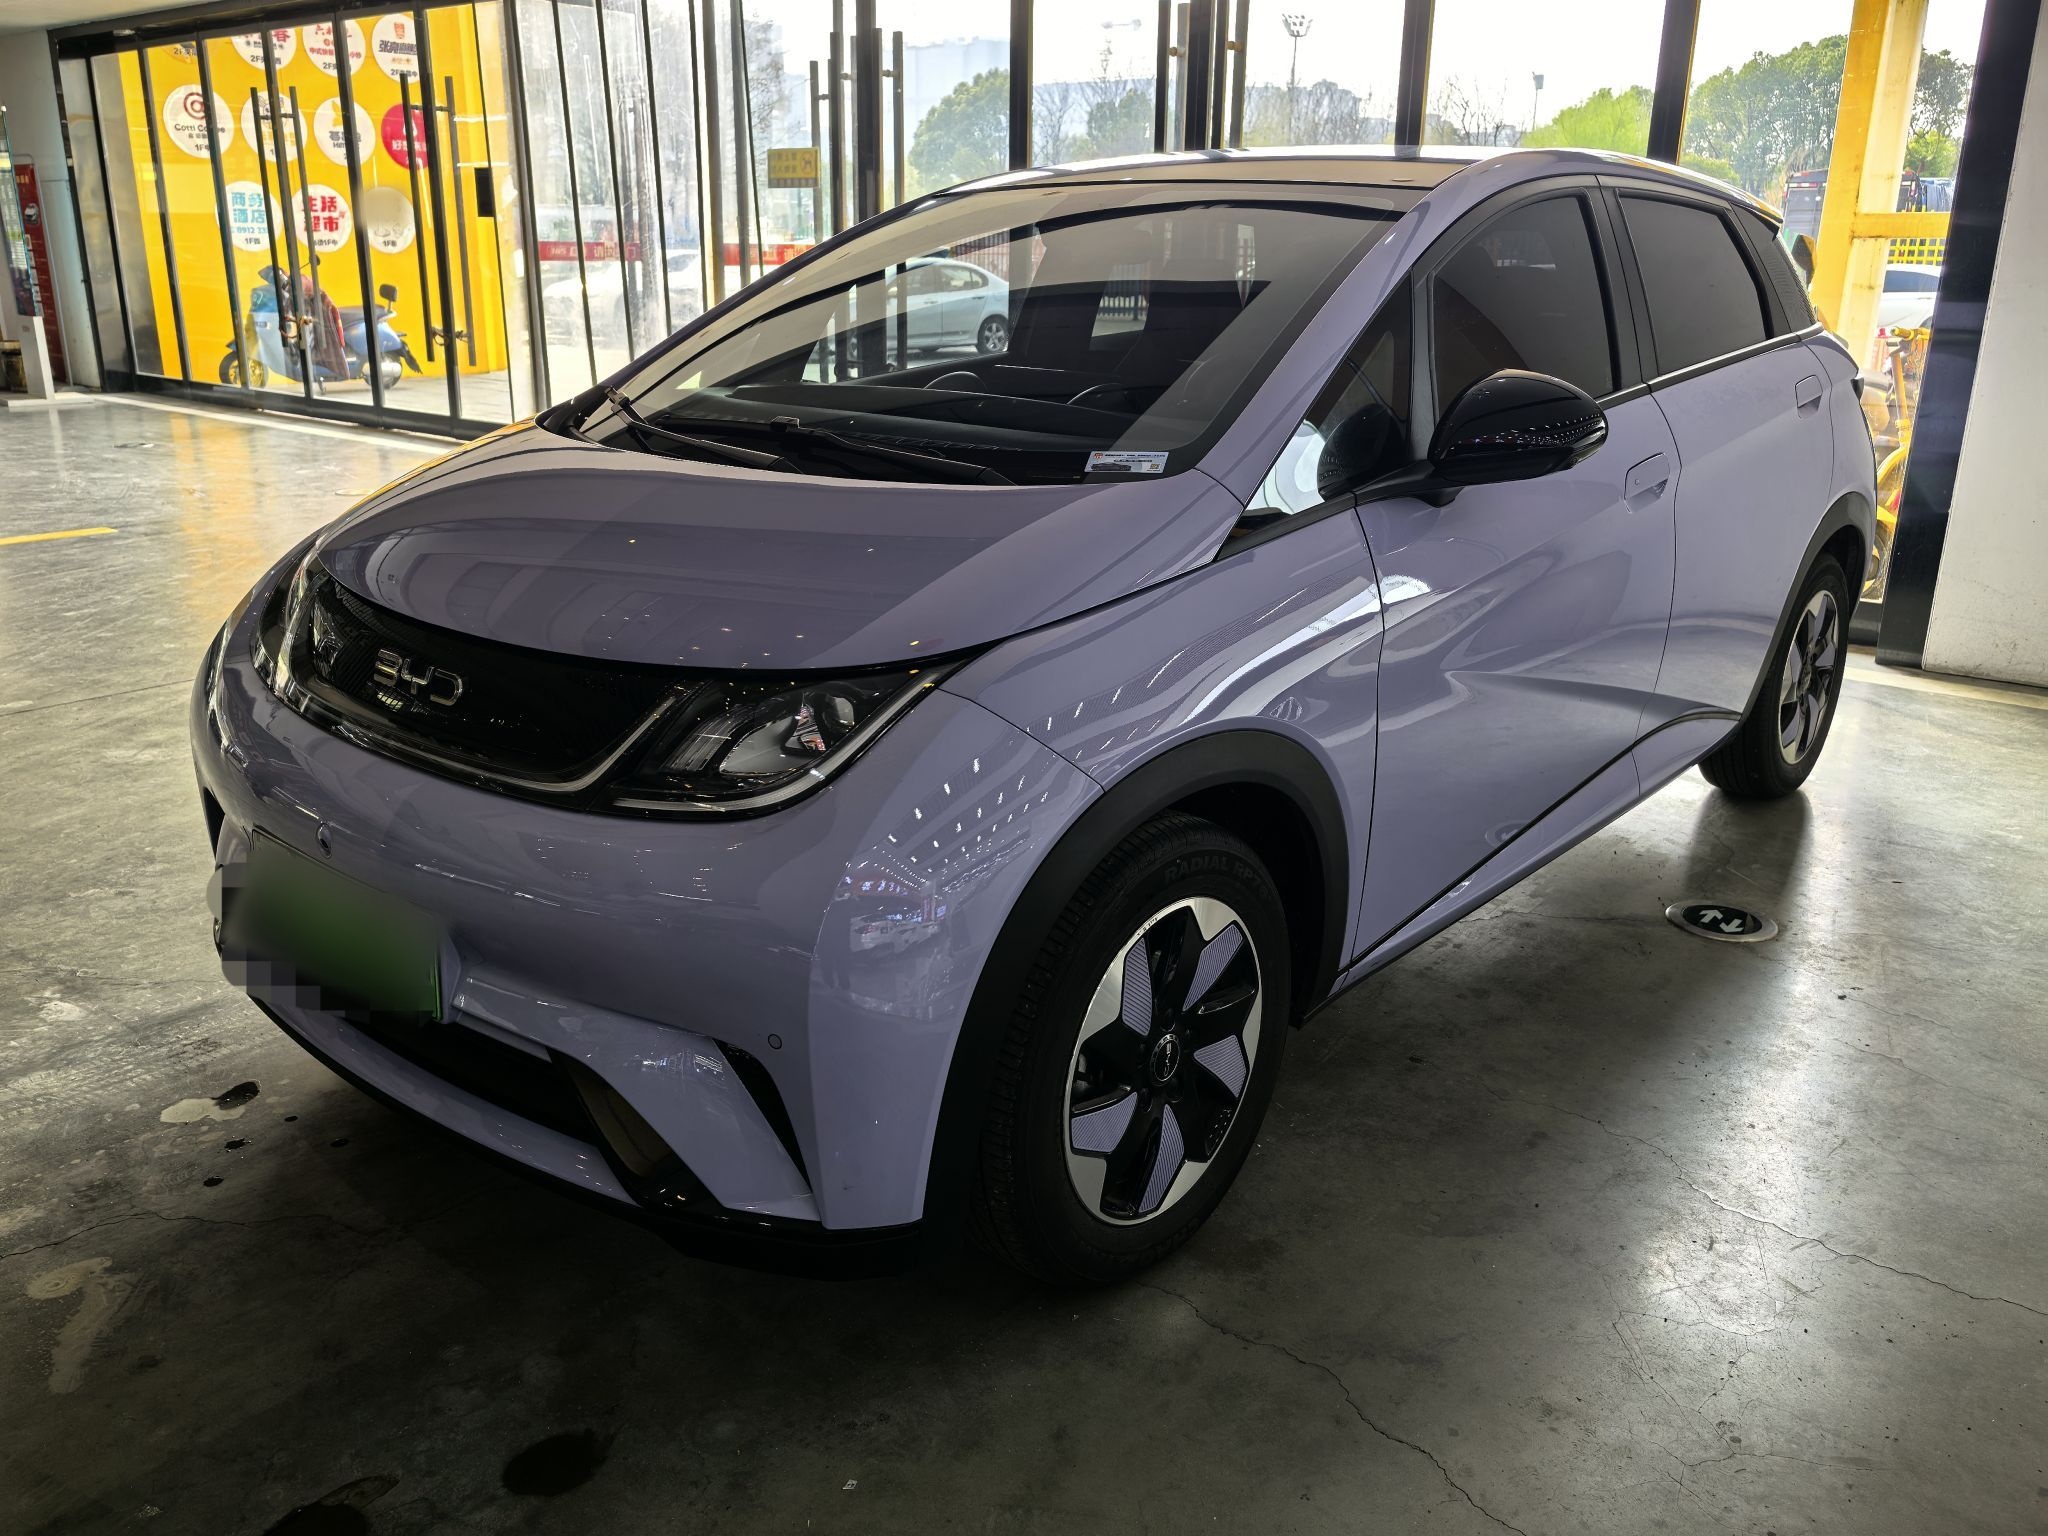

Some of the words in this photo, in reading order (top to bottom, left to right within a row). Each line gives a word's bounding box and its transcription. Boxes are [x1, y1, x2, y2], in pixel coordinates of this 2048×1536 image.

[174, 124, 196, 132] Cotti
[198, 125, 225, 133] Coee
[233, 208, 267, 224] 酒店
[373, 648, 464, 706] BYD
